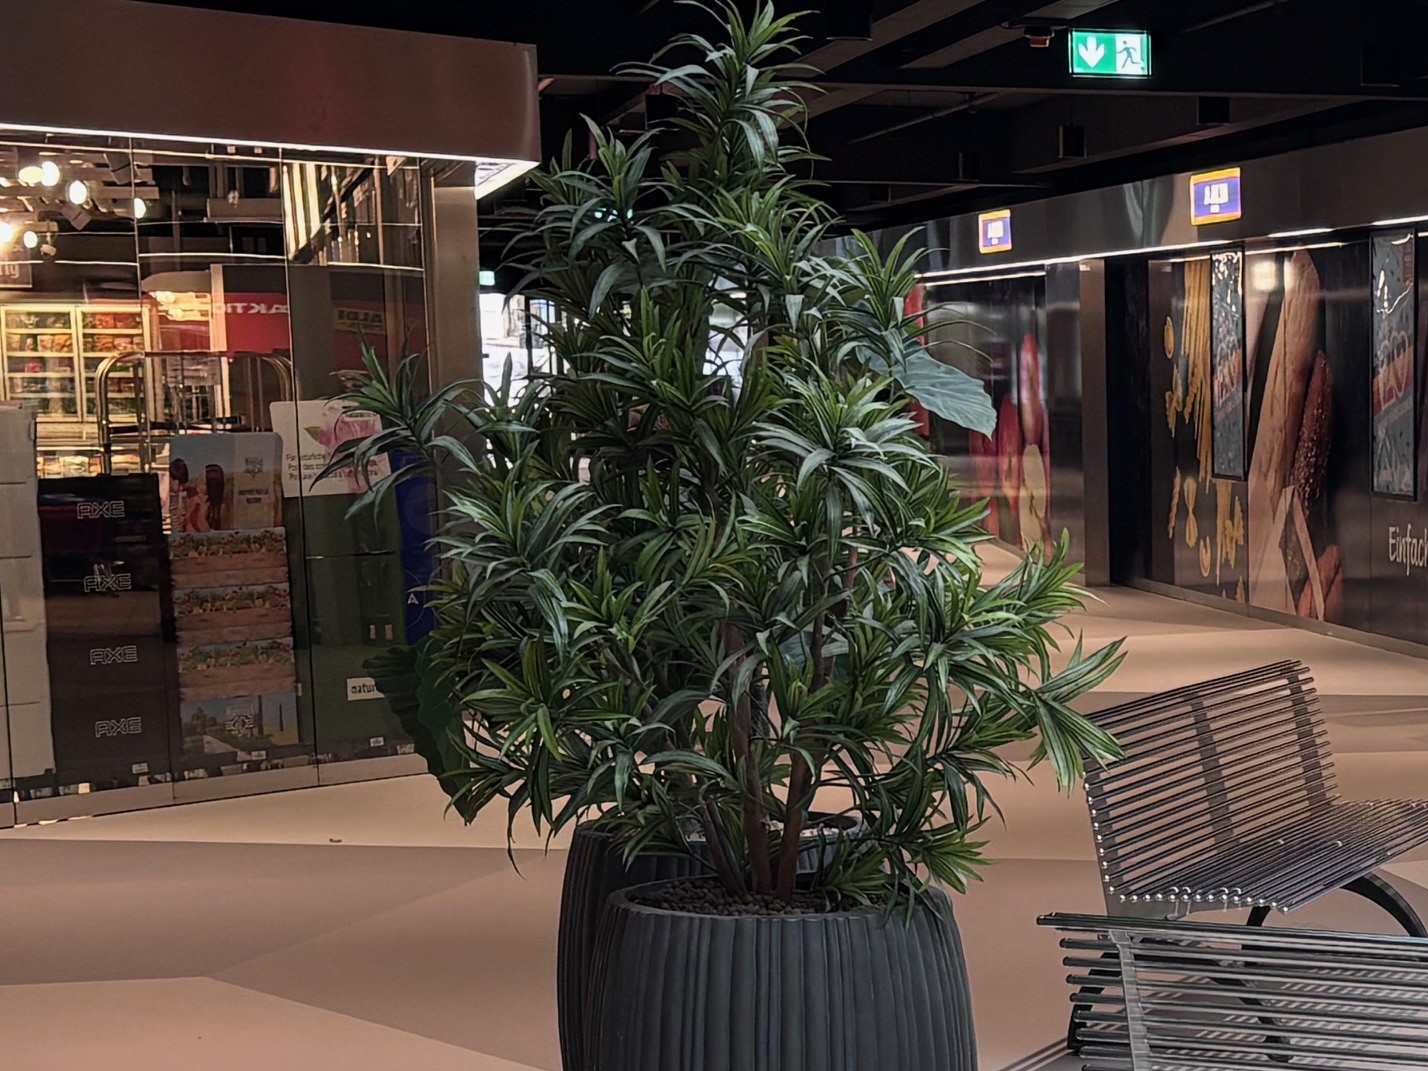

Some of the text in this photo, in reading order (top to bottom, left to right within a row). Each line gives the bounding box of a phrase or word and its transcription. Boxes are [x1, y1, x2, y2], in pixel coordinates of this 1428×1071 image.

[77, 500, 125, 519] AXE
[83, 573, 132, 593] AXE
[90, 645, 138, 666] AXE
[94, 716, 142, 738] AXE
